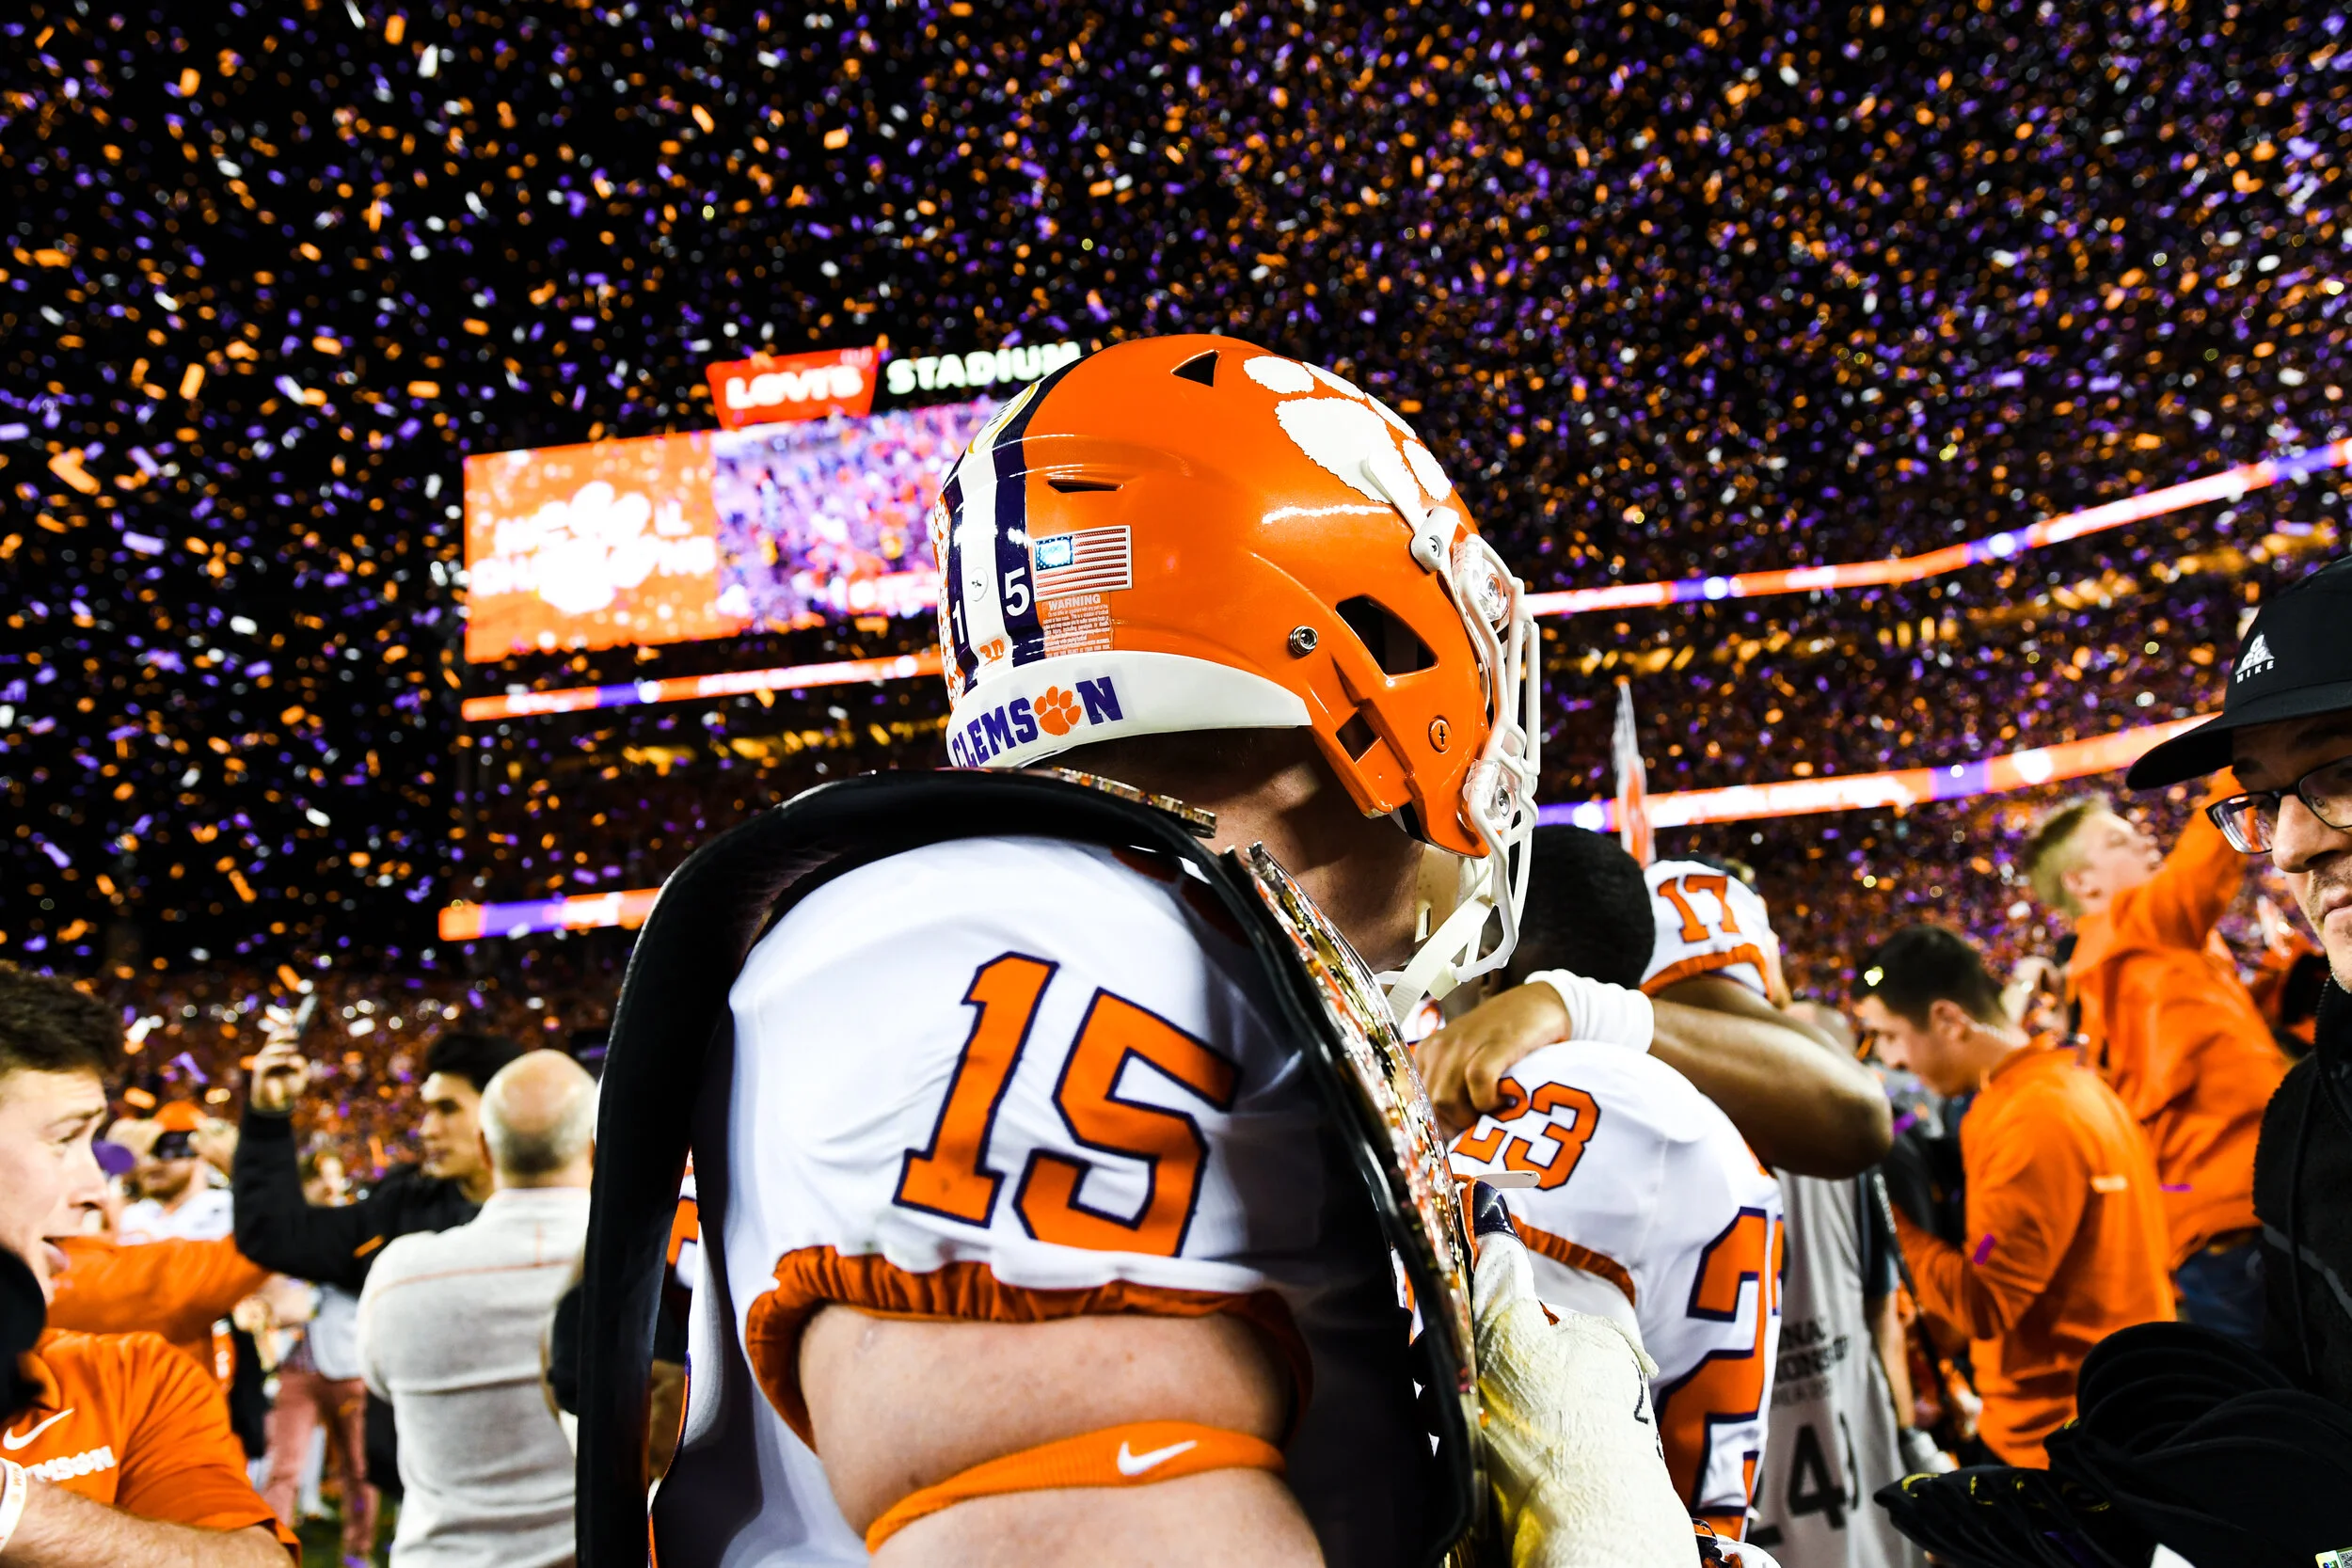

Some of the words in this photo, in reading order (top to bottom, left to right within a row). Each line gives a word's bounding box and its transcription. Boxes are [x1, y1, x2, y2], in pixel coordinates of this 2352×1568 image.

[886, 341, 1081, 395] STADIUM
[1048, 593, 1102, 611] WARNING
[2236, 659, 2275, 684] NIKE
[1657, 873, 1741, 944] 17
[891, 950, 1244, 1259] 15
[1452, 1076, 1600, 1192] 23
